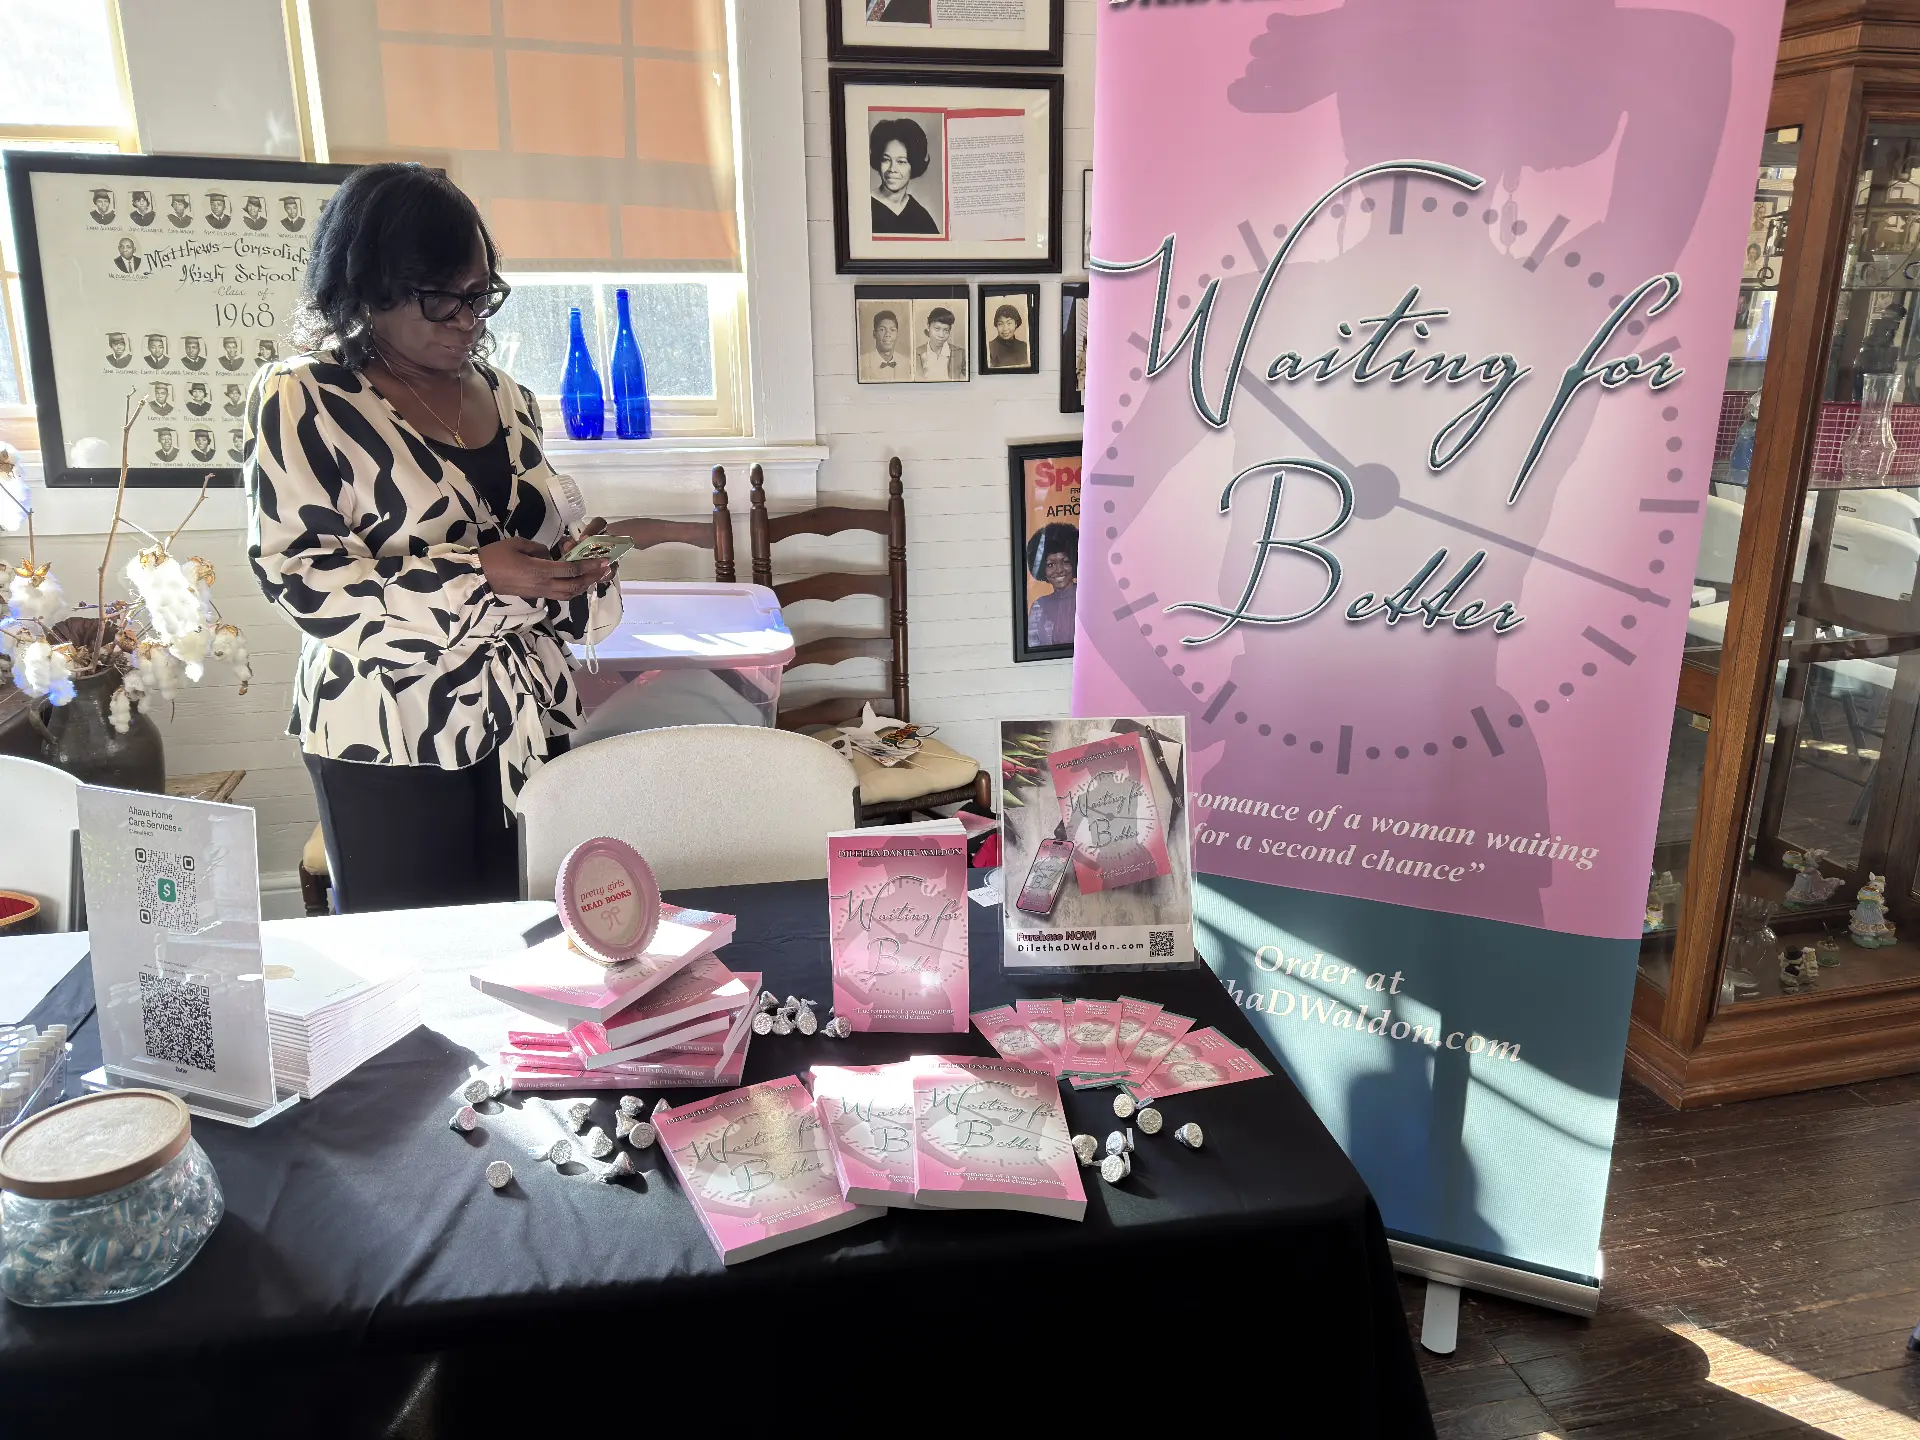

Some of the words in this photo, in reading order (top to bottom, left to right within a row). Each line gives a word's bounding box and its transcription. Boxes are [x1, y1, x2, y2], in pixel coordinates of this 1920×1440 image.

[175, 264, 225, 292] High
[234, 264, 304, 285] School
[214, 303, 275, 328] 1968
[1090, 159, 1531, 470] Waiting
[1507, 272, 1684, 504] for
[1163, 456, 1526, 645] Better
[128, 806, 150, 817] Ahava
[151, 809, 173, 820] Home
[128, 817, 145, 827] Care
[146, 819, 178, 832] Services
[882, 848, 918, 857] DANIEL
[920, 848, 963, 857] WALDON
[1307, 804, 1342, 832] of
[1344, 812, 1362, 830] a
[1371, 816, 1475, 846] woman
[1487, 832, 1600, 871] waiting
[1236, 835, 1253, 851] a
[1259, 838, 1356, 866] second
[1361, 849, 1486, 882] chance”
[580, 886, 604, 902] pretty
[607, 880, 625, 893] girls
[581, 900, 603, 912] READ
[605, 889, 632, 903] BOOKS
[830, 875, 932, 936] Waiting
[930, 899, 961, 942] for
[1016, 931, 1064, 942] Purchase
[1065, 930, 1096, 941] NOW!
[1017, 942, 1144, 952] DilethaDWaldon.com
[1254, 945, 1357, 985] Order
[1365, 969, 1405, 995] at
[1219, 978, 1521, 1062] haDWaldon.com
[914, 1081, 1027, 1123] Waiting
[1026, 1102, 1058, 1128] for
[798, 1114, 822, 1148] for
[944, 1120, 1042, 1151] Better
